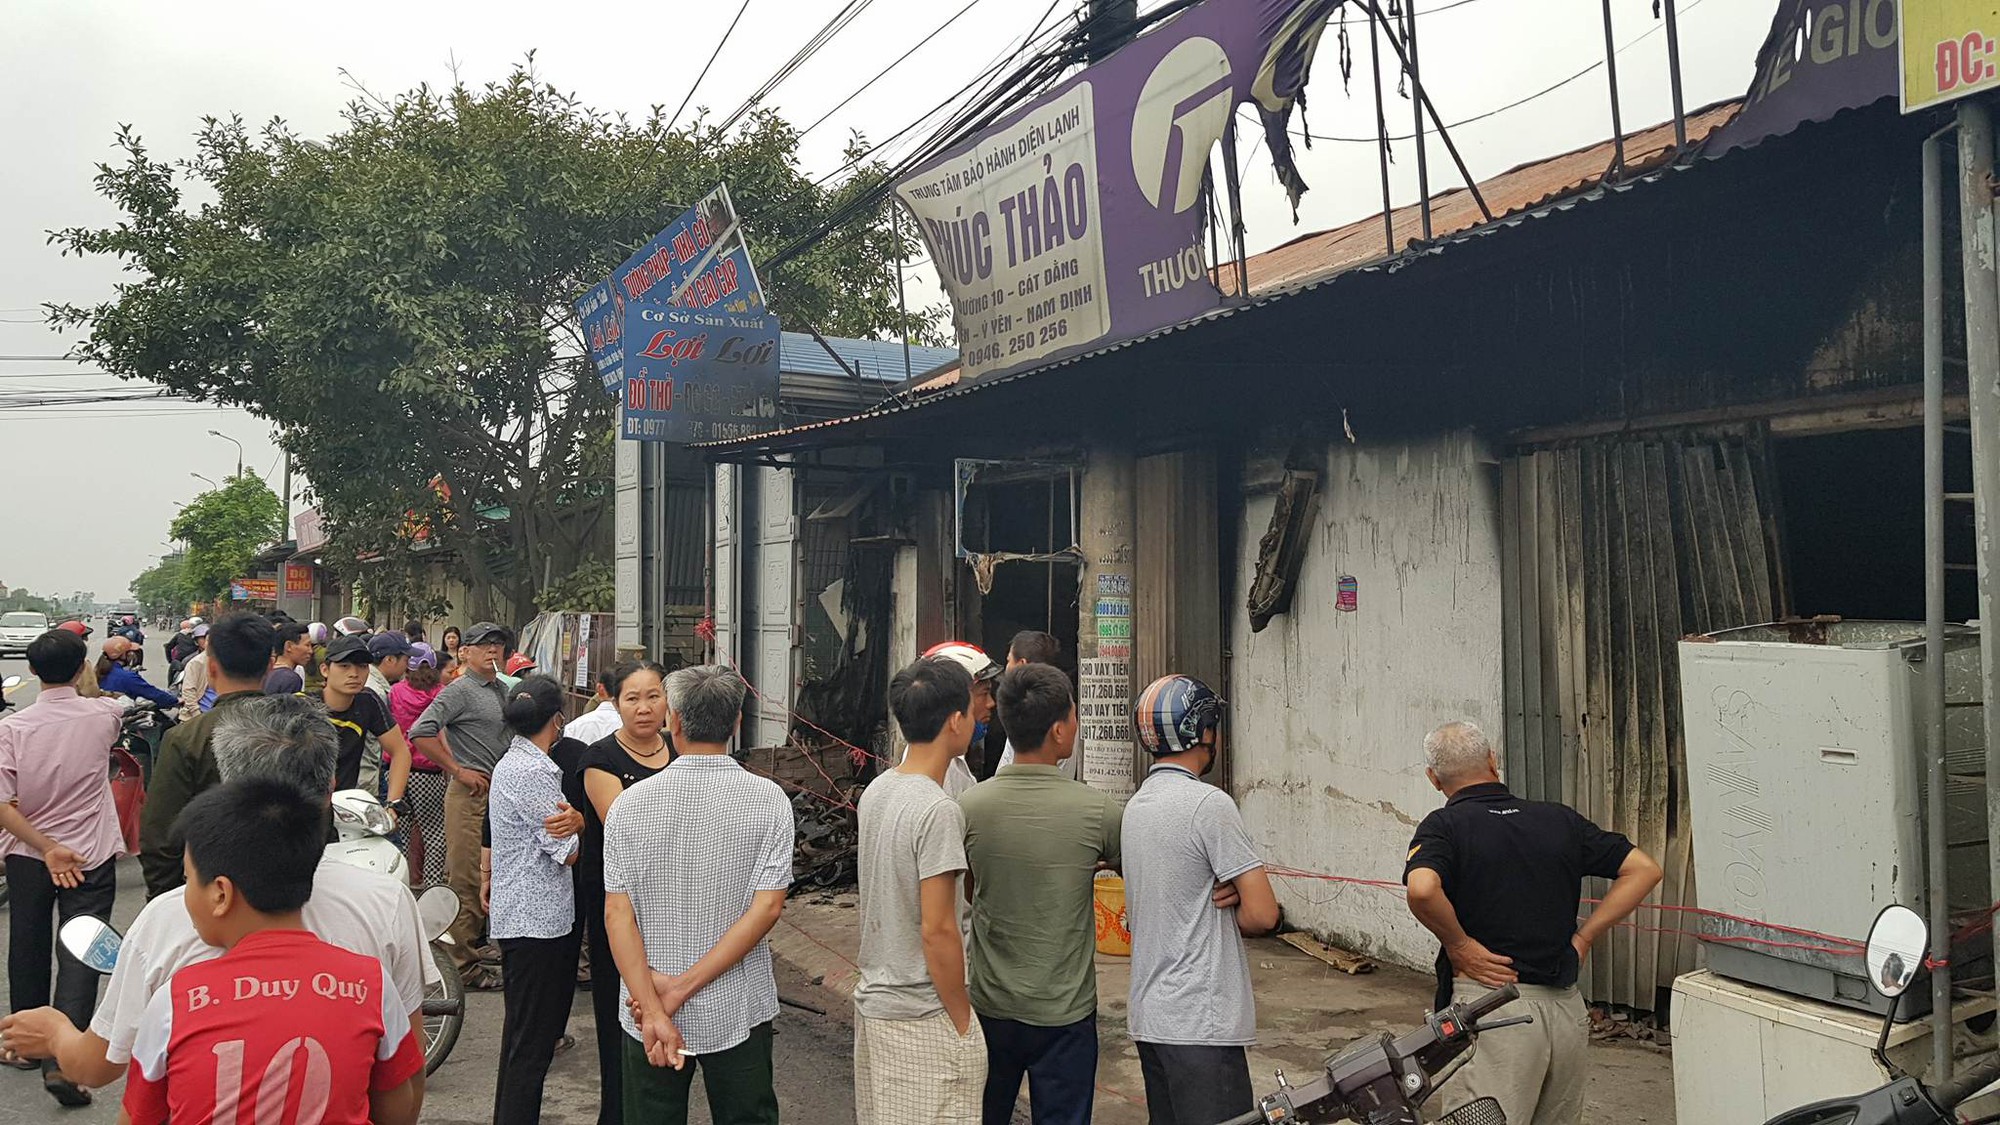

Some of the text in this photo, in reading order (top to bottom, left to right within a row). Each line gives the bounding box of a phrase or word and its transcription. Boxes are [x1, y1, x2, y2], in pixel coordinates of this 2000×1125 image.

[1935, 31, 1994, 93] ĐC:
[908, 105, 1079, 200] TRUNG TÂM BẢO HÀNH ĐIỆN LẠNH
[925, 153, 1087, 285] PHÚC THẢO
[695, 271, 720, 309] CAO
[715, 246, 739, 297] CẤP
[991, 289, 1003, 307] 10
[1018, 274, 1040, 297] CÁT
[1044, 259, 1079, 287] ĐẰNG
[641, 309, 765, 330] Cơ Sở Sản Xuất
[991, 314, 1012, 336] YÊN
[1027, 298, 1056, 324] NAM
[1060, 284, 1092, 312] ĐỊNH
[635, 329, 707, 367] Lợi
[710, 336, 775, 371] Lợi
[1009, 331, 1035, 355] 250
[1040, 319, 1067, 345] 256
[627, 417, 641, 434] ĐT:
[1081, 663, 1093, 675] CHO
[1095, 663, 1110, 675] VAY
[1081, 685, 1129, 699] 0917.260.666
[1081, 704, 1093, 716] CHO
[1095, 704, 1110, 716] VAY
[1081, 725, 1129, 740] 0917.260.666
[187, 972, 368, 1012] B. Duy Quý
[211, 1036, 332, 1125] 10
